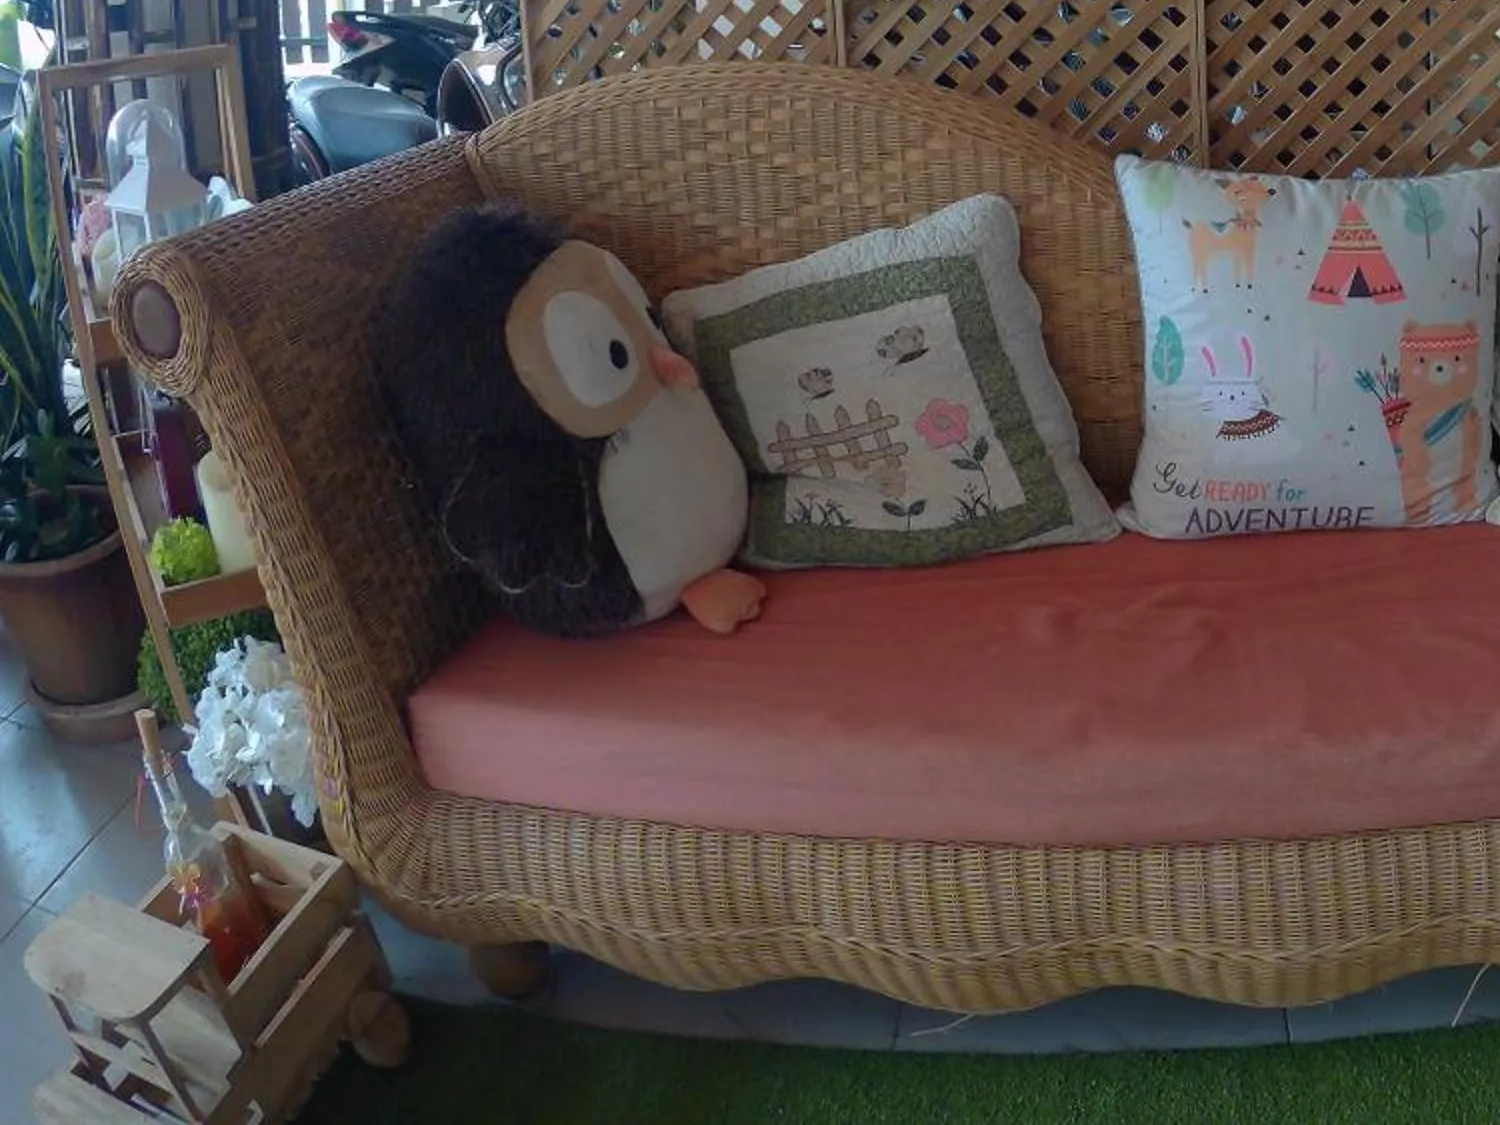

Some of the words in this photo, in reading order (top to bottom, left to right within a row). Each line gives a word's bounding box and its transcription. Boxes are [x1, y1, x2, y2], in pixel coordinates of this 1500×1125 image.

[1152, 461, 1200, 500] Get
[1204, 479, 1271, 505] READY
[1276, 478, 1306, 503] for
[1185, 506, 1375, 535] ADVENTURE
